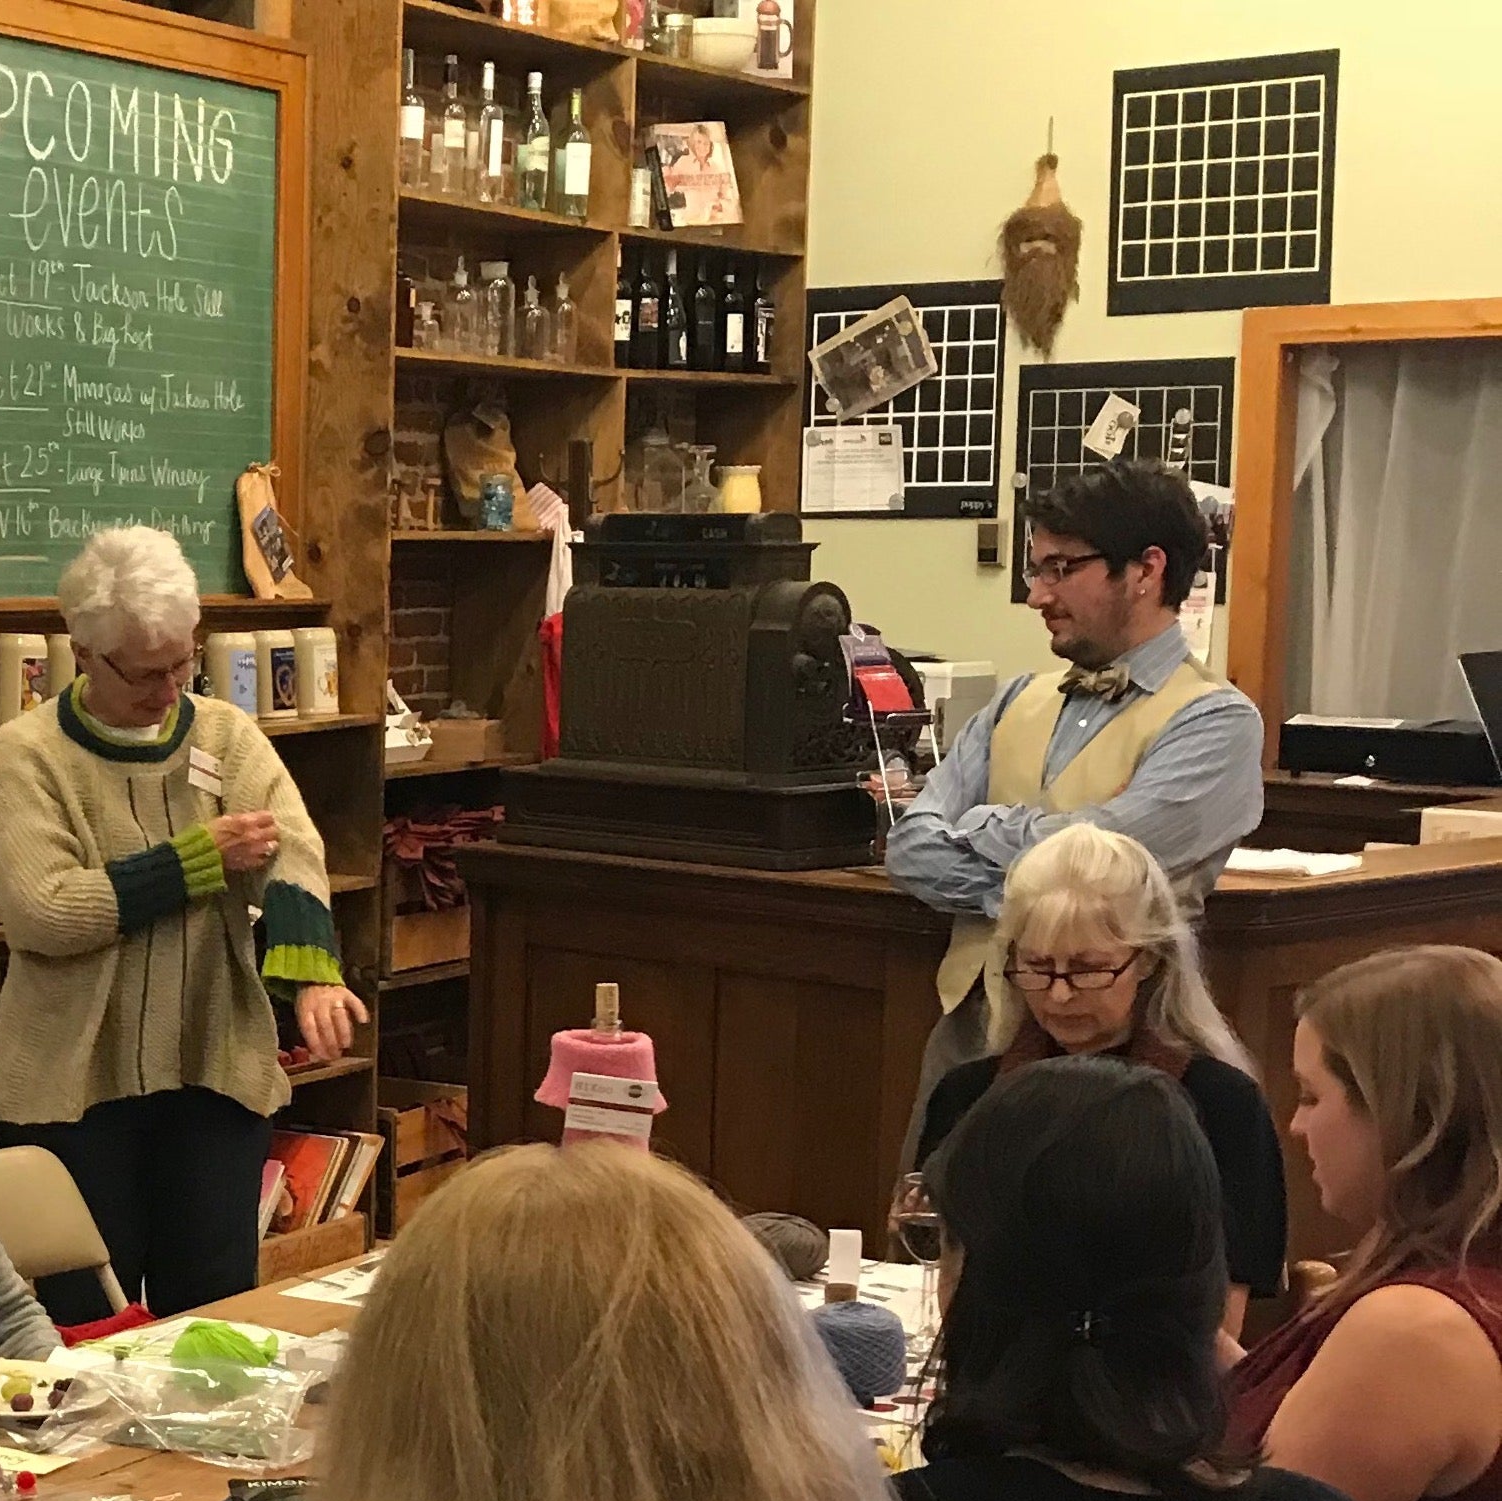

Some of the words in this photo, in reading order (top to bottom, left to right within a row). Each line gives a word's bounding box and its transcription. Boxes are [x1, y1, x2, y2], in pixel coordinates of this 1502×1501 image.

[9, 166, 184, 261] events
[70, 263, 149, 310] Jackson
[156, 277, 188, 314] Hole
[6, 304, 66, 339] Works
[73, 310, 86, 344] &
[62, 363, 133, 406] Mimosas
[160, 373, 209, 412] Jackson
[213, 381, 245, 412] Hole
[246, 1478, 310, 1489] KIMON
